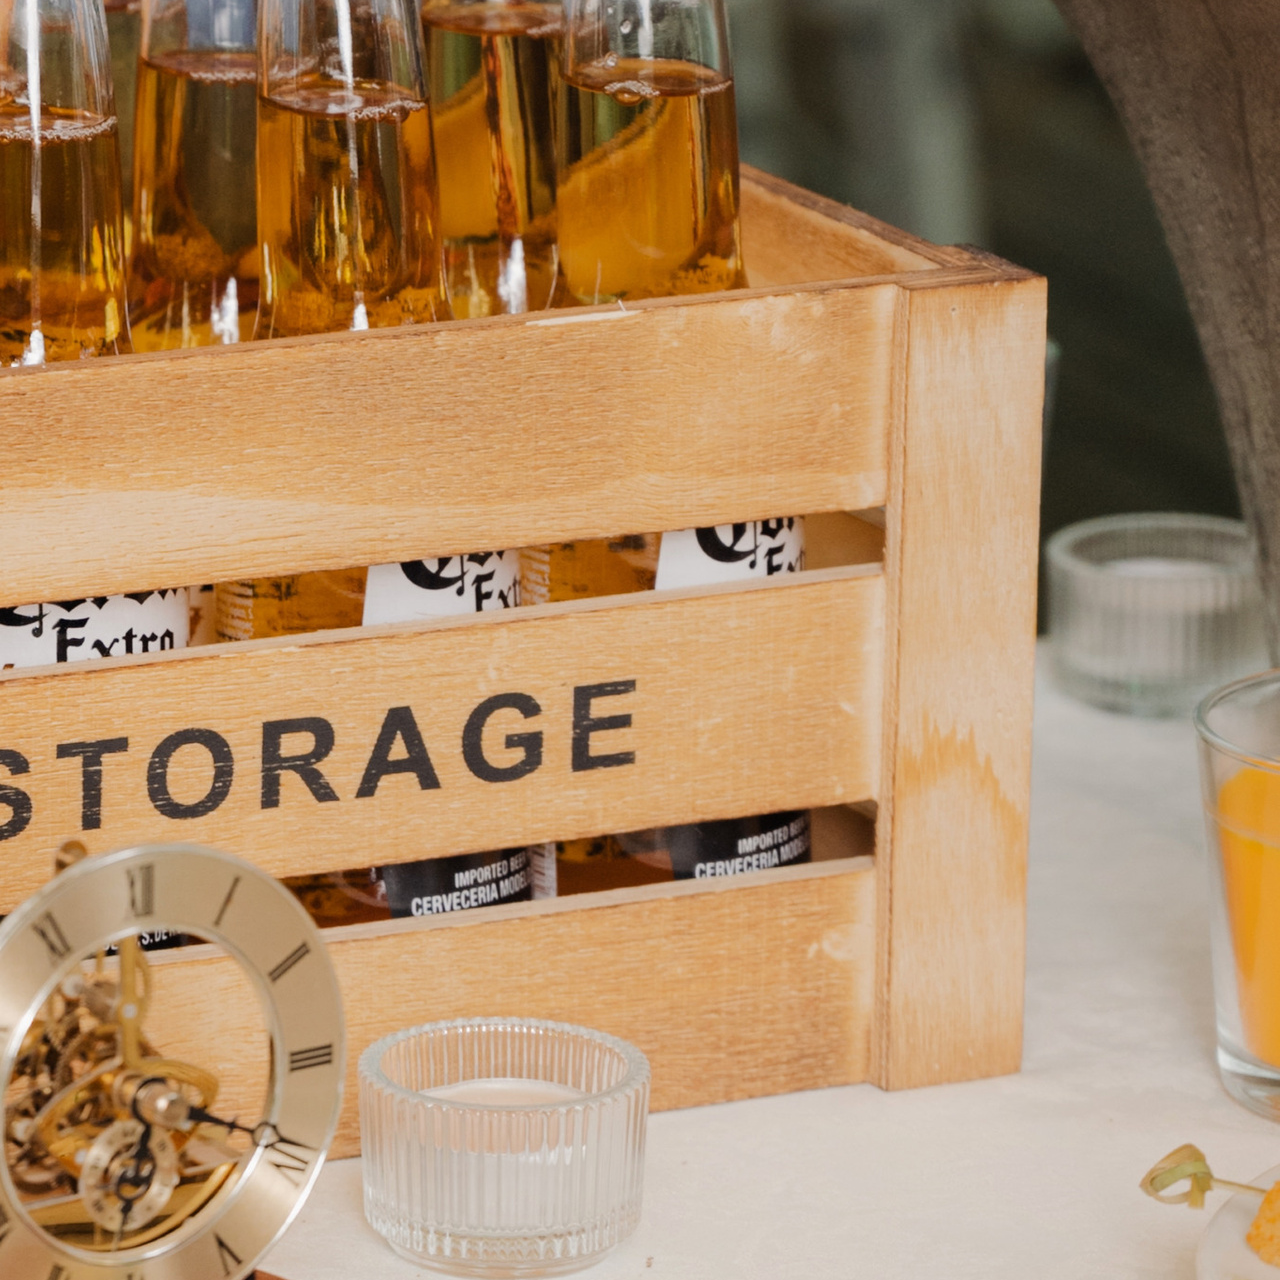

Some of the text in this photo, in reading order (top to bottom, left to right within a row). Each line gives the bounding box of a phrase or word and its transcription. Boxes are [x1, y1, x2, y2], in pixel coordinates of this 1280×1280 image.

[52, 617, 175, 663] Extra
[737, 824, 789, 855] IMPORTED
[454, 859, 509, 889] IMPORTED
[694, 847, 780, 880] CERVECERIA
[410, 882, 499, 917] CERVECERIA
